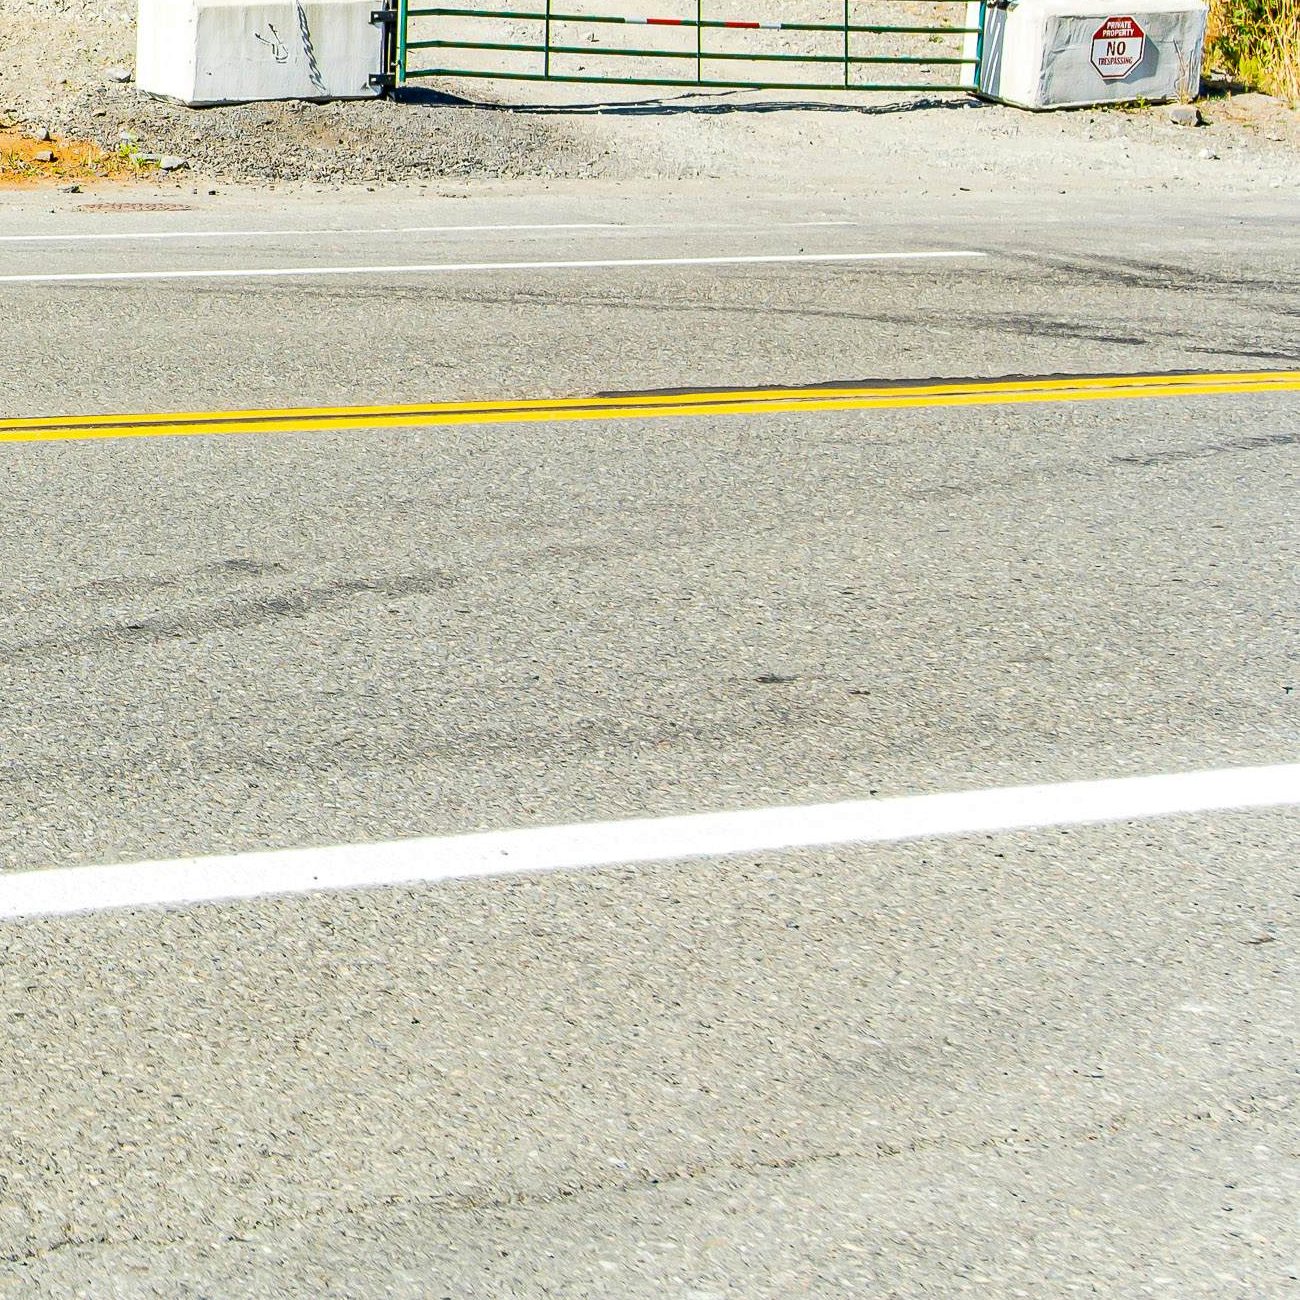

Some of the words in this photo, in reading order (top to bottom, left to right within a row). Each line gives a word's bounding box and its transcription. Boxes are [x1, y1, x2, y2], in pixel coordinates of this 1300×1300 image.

[1106, 21, 1132, 29] PRIVATE
[1102, 29, 1134, 37] PROPERTY
[1106, 41, 1126, 56] NO
[1098, 57, 1133, 66] TRESPASSING
